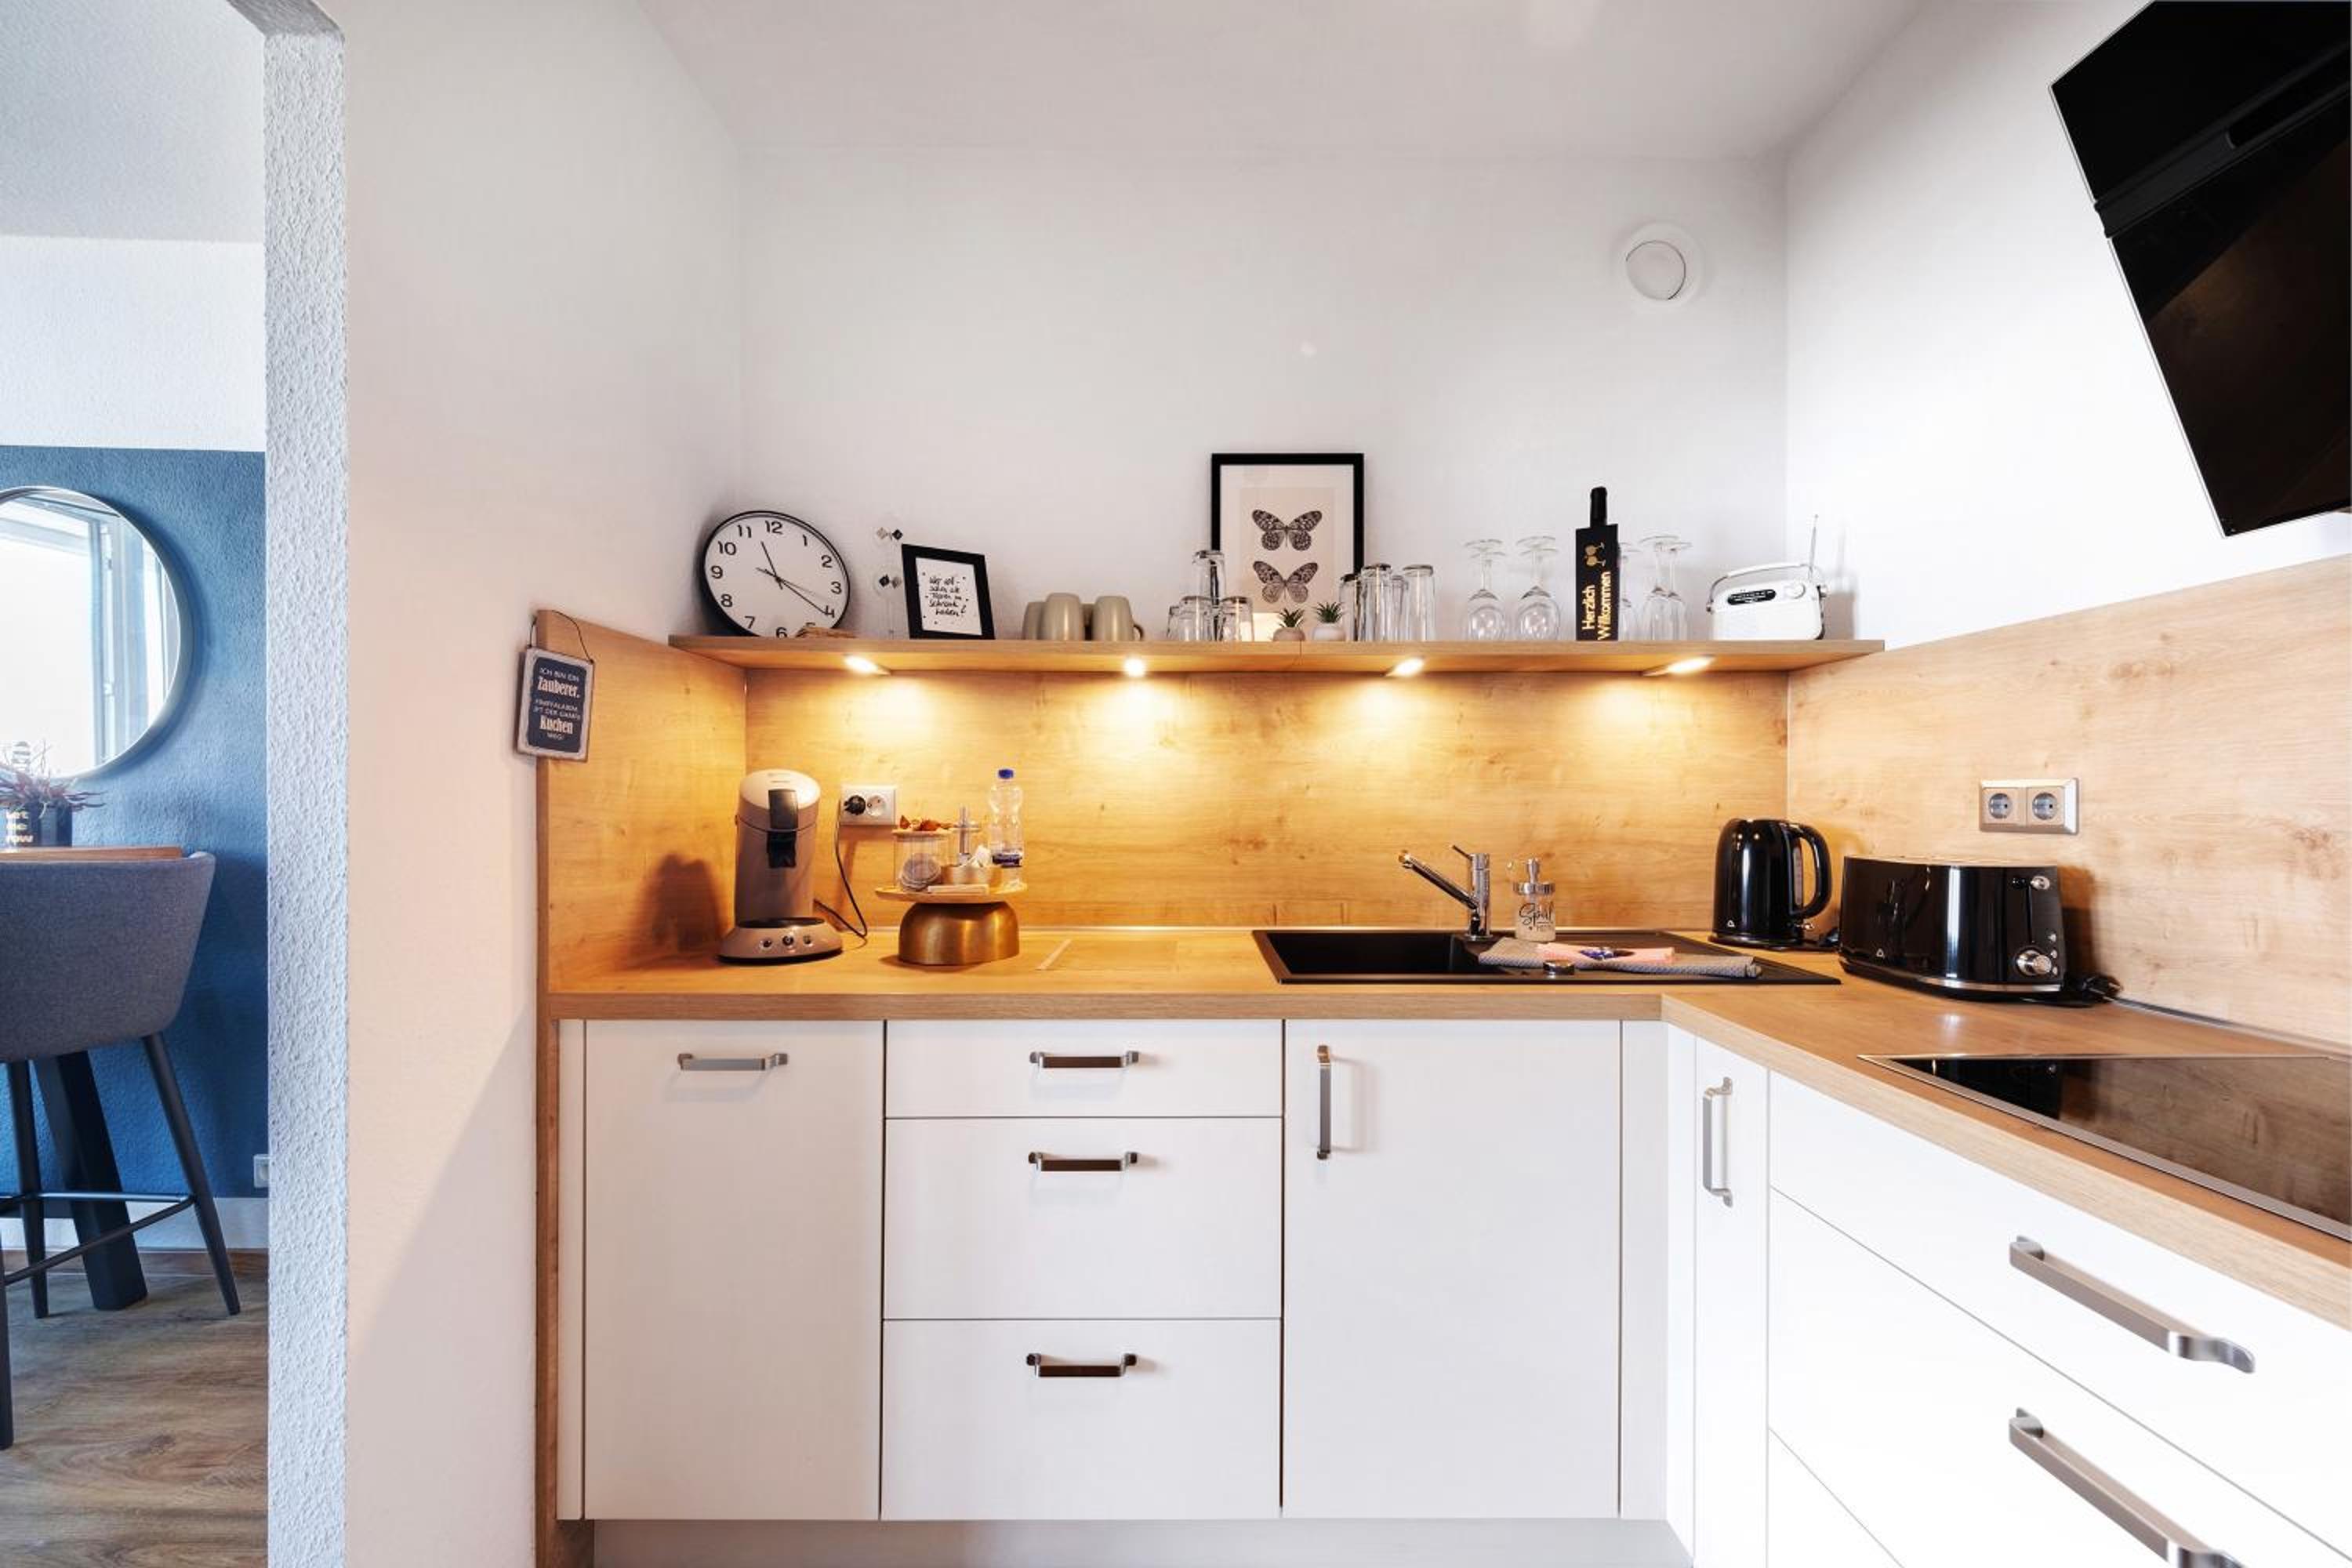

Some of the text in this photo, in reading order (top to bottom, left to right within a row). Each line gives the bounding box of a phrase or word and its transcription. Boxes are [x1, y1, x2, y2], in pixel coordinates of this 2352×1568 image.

[737, 524, 752, 538] 11
[765, 520, 783, 535] 12
[802, 534, 808, 546] 1
[717, 540, 737, 555] 10
[821, 554, 833, 568] 2
[710, 565, 724, 579] 9
[830, 581, 843, 594] 3
[720, 593, 733, 608] 8
[1581, 584, 1595, 630] Herzlich
[1597, 571, 1612, 641] Willkommen
[824, 605, 836, 618] 4
[744, 615, 756, 629] 7
[775, 626, 788, 637] 6
[539, 714, 573, 735] Kuchen
